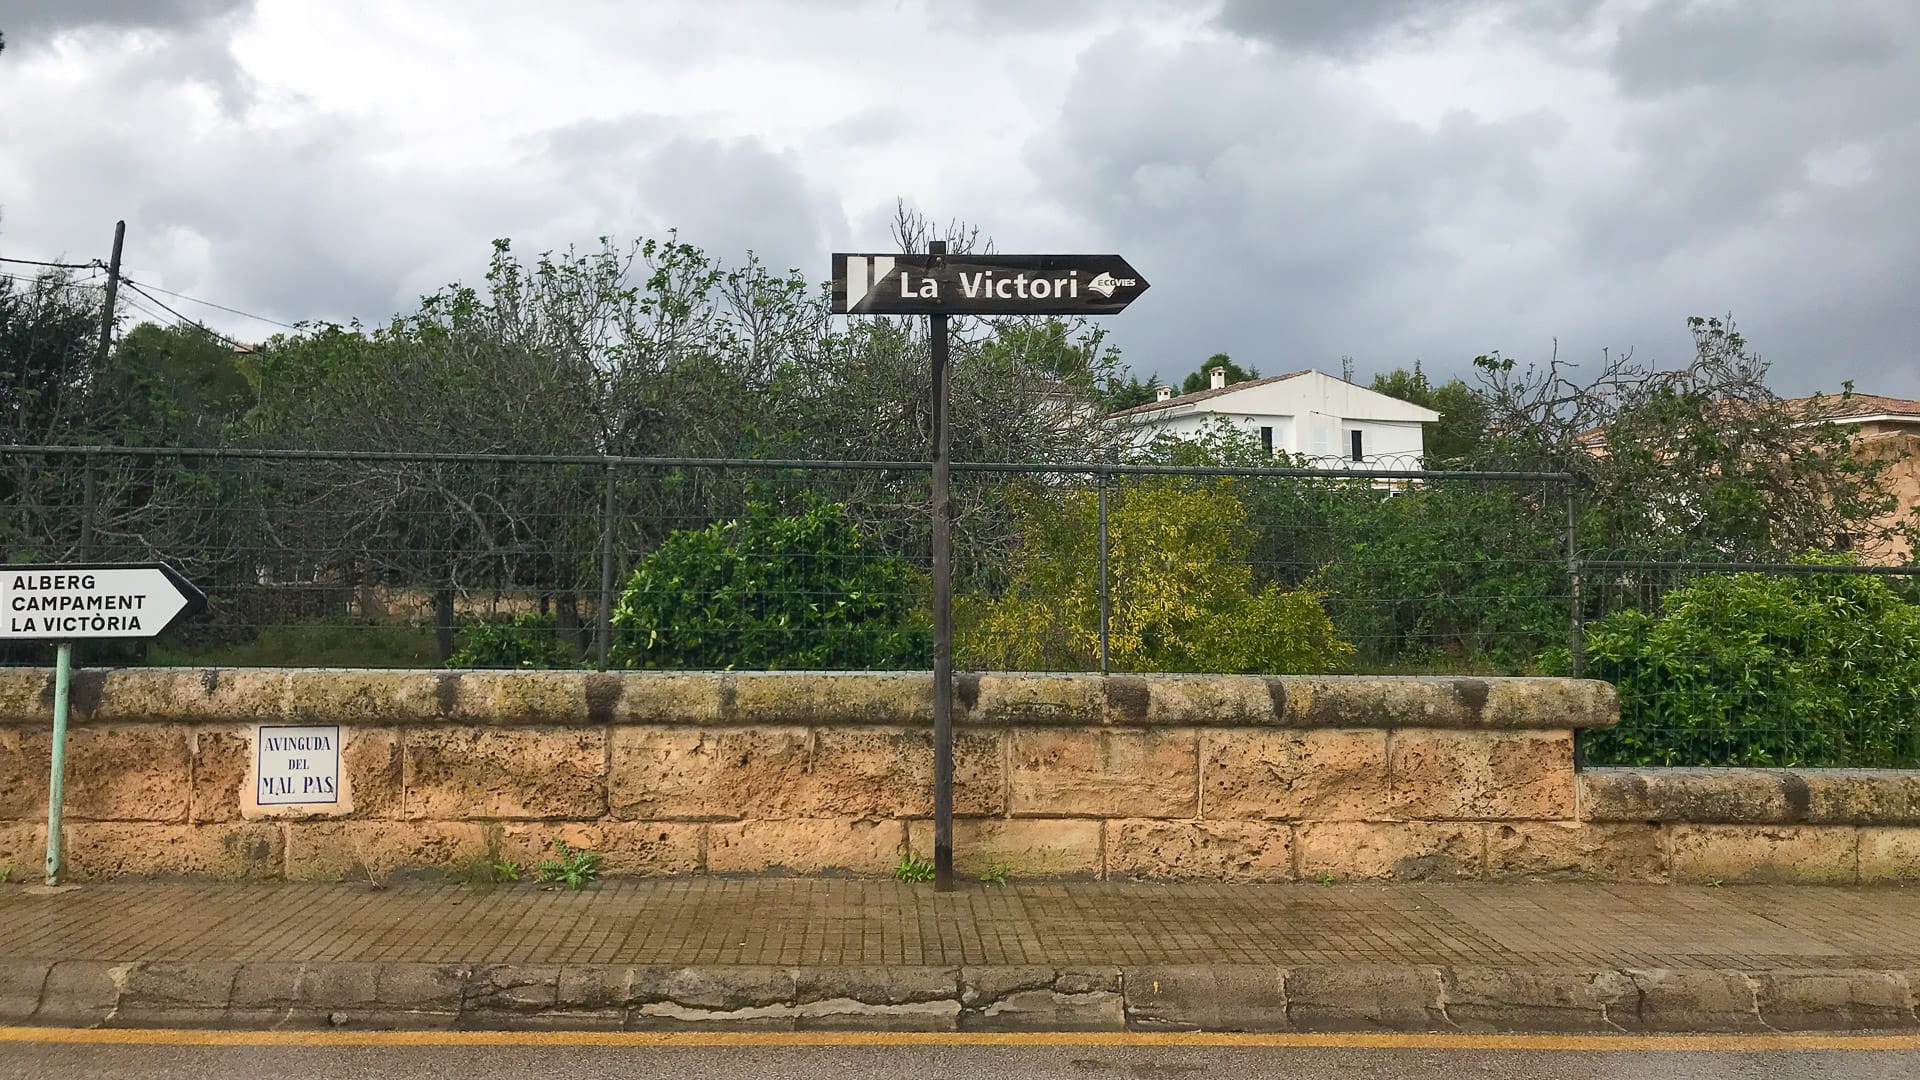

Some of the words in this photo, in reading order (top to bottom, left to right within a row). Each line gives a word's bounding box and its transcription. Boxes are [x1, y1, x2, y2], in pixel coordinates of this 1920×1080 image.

[901, 271, 938, 298] La
[959, 270, 1078, 299] Victori
[12, 575, 95, 589] ALBERG
[12, 595, 146, 611] CAMPAMENT
[11, 617, 36, 632] LA
[44, 613, 141, 631] VICTÒRIA
[264, 736, 330, 751] AVINGUDA
[288, 759, 309, 770] DEL
[262, 777, 295, 795] MAL
[303, 776, 334, 793] PAS
